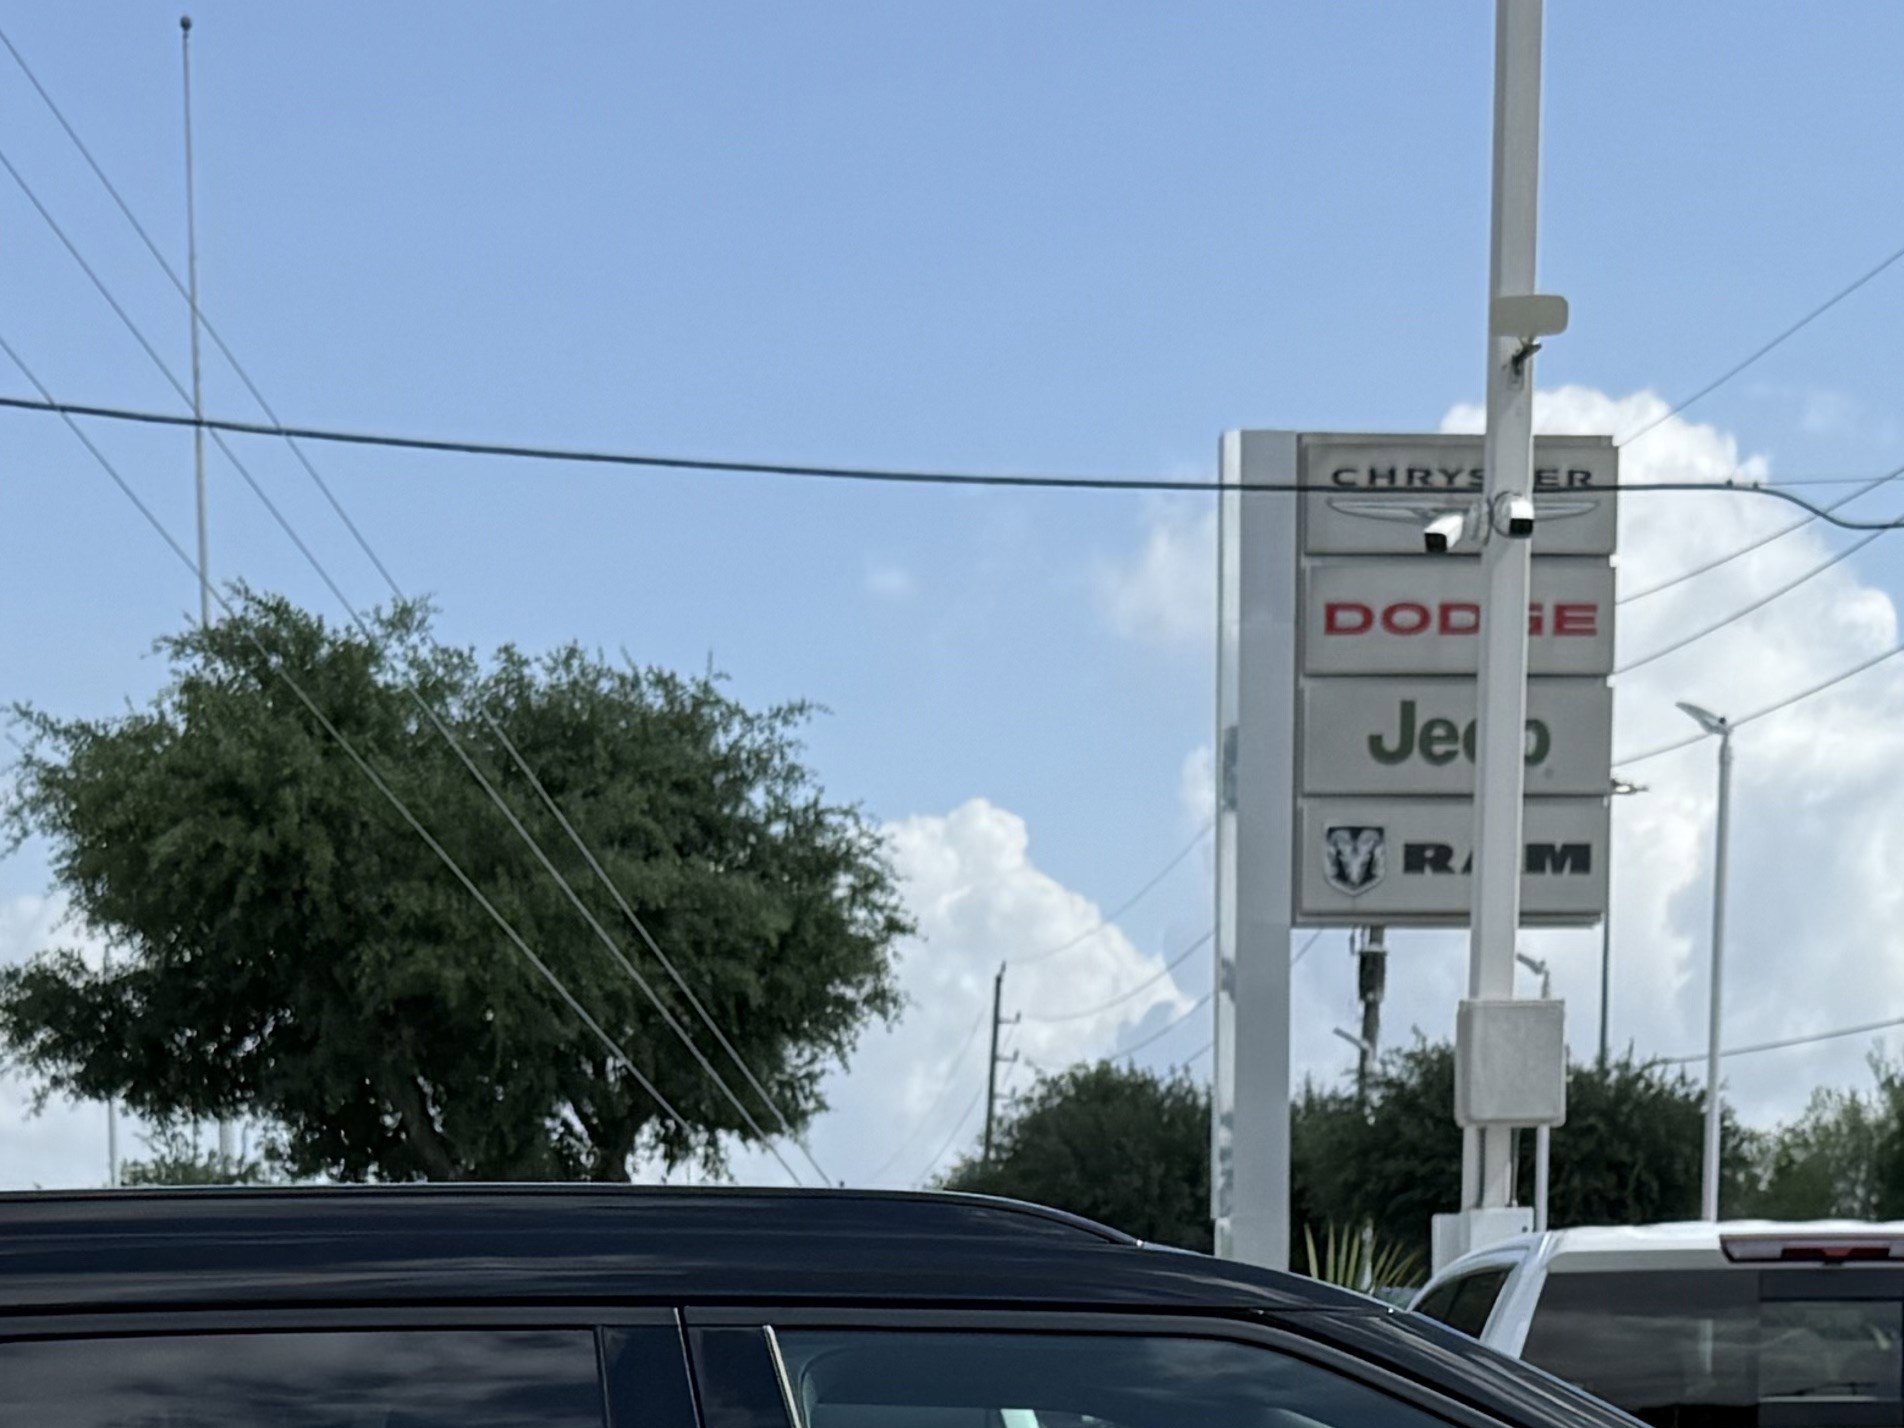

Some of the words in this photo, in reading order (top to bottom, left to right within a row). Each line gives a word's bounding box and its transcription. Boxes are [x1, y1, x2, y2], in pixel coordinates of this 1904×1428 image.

[1331, 465, 1593, 489] CHRYSER
[1323, 602, 1599, 636] DODE
[1402, 842, 1591, 875] RM
